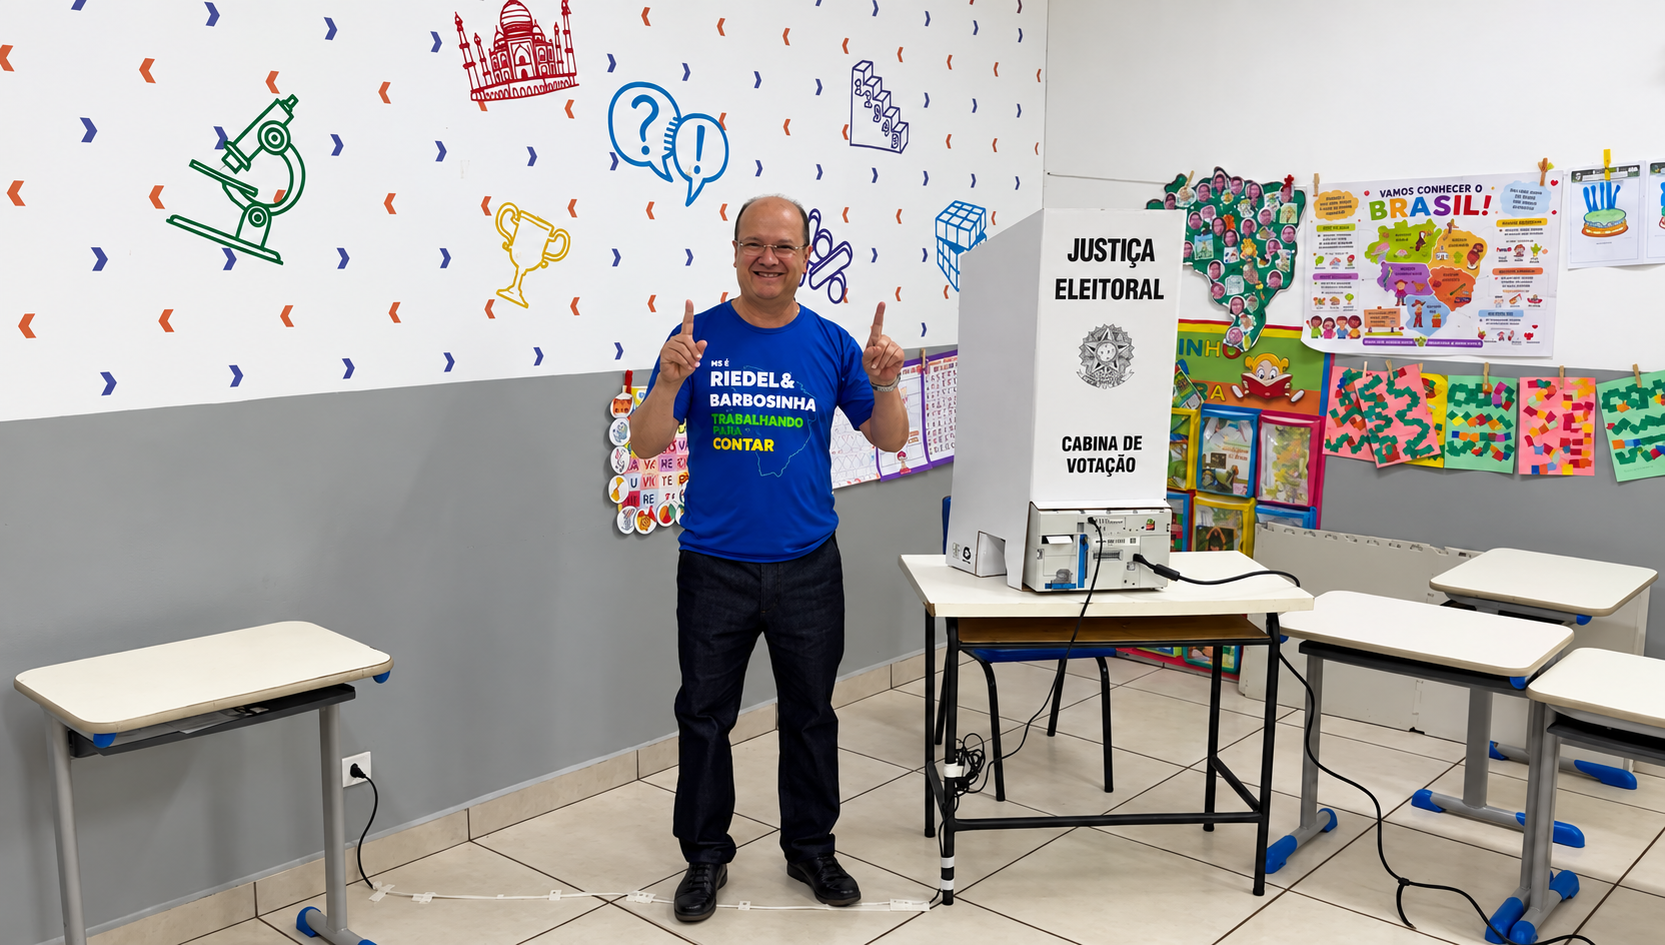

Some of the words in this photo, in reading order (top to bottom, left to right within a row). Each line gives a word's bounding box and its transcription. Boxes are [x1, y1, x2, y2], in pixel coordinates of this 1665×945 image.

[1379, 186, 1414, 198] VAMOS
[1417, 184, 1472, 195] CONHECER
[1474, 184, 1483, 193] O
[1368, 194, 1492, 221] BRASIL!
[1067, 237, 1156, 268] JUSTIÇA
[1055, 278, 1164, 300] ELEITORAL
[709, 393, 816, 412] BARBOSINHA
[711, 413, 804, 428] TRABALHANDO
[713, 437, 775, 452] CONTAR
[1061, 435, 1118, 452] CABINA
[1123, 435, 1143, 451] DE
[1066, 454, 1136, 477] VOTAÇÃO
